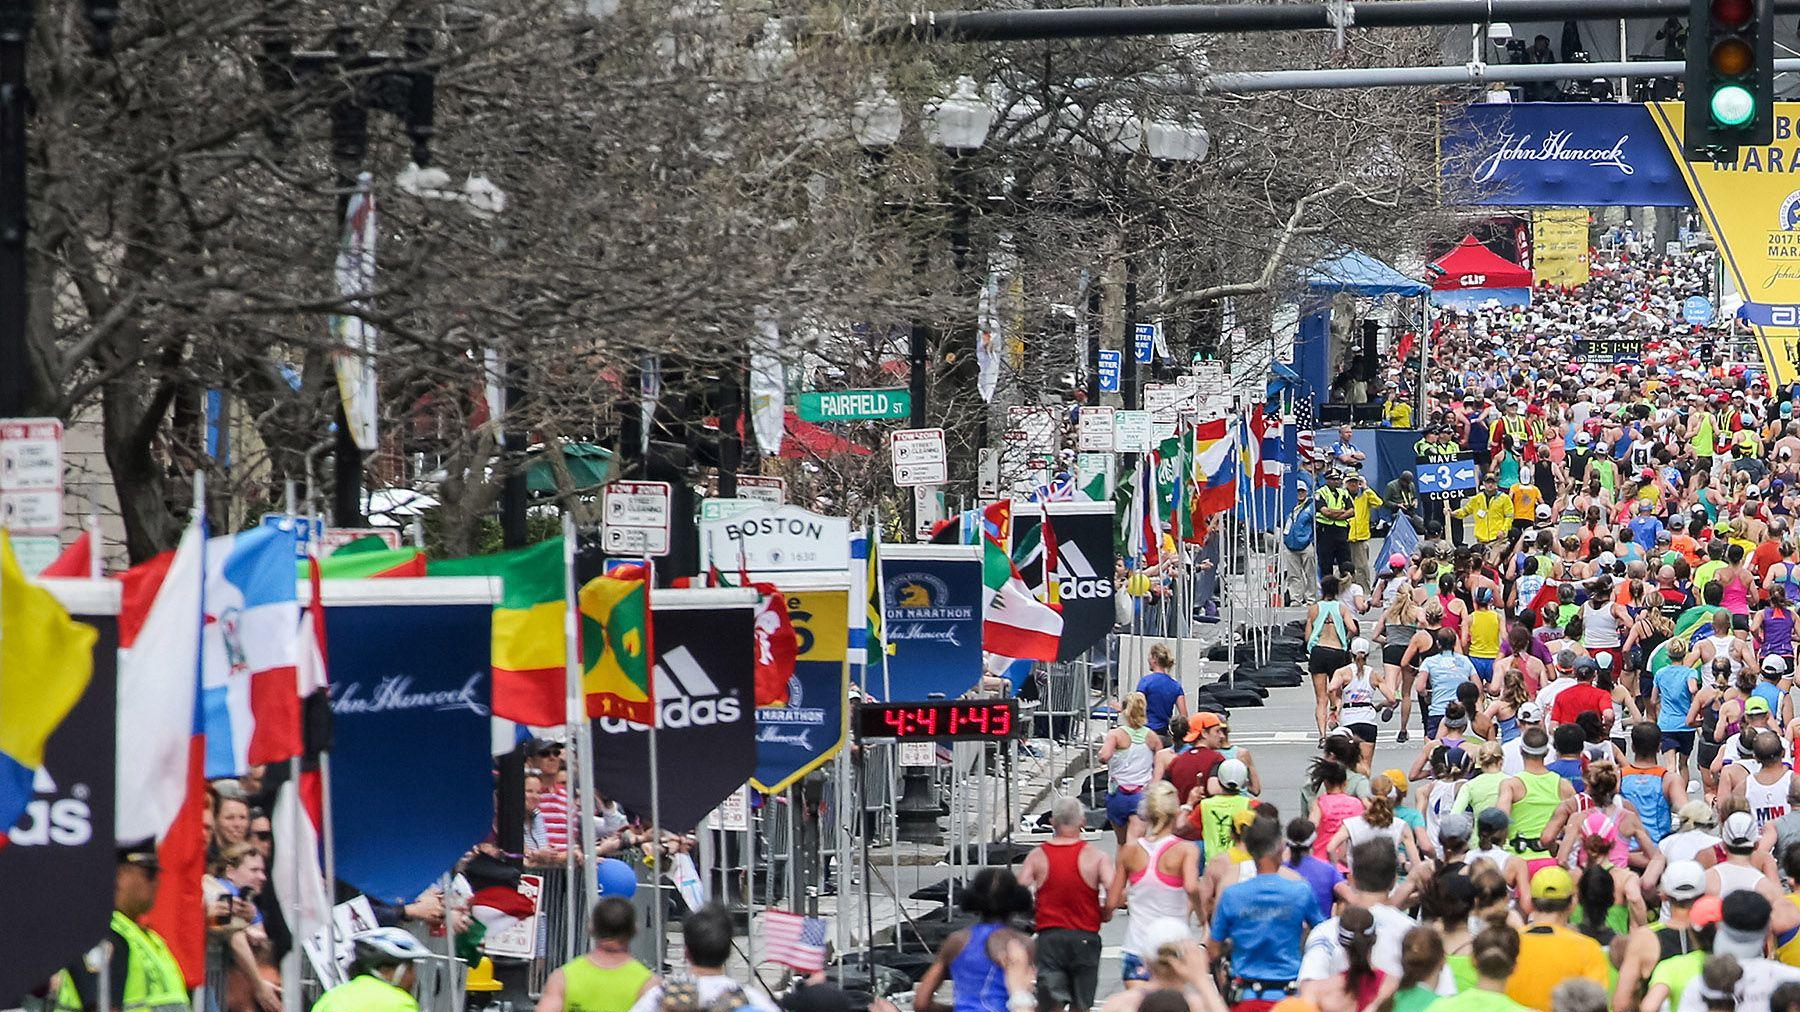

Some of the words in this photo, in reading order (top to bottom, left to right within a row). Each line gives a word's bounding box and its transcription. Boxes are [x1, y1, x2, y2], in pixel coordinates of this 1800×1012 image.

[1536, 130, 1634, 175] Hancock
[1768, 234, 1793, 244] 2017
[1459, 274, 1486, 287] CLIF
[820, 394, 889, 416] FAIRFIELD
[892, 403, 903, 413] ST
[1428, 453, 1458, 464] WAVE
[1437, 465, 1453, 489] 3
[1429, 489, 1465, 501] CLOCK
[725, 517, 823, 541] BOSTON
[1059, 576, 1112, 601] das
[906, 608, 972, 619] MARATHON
[600, 695, 741, 734] aidas
